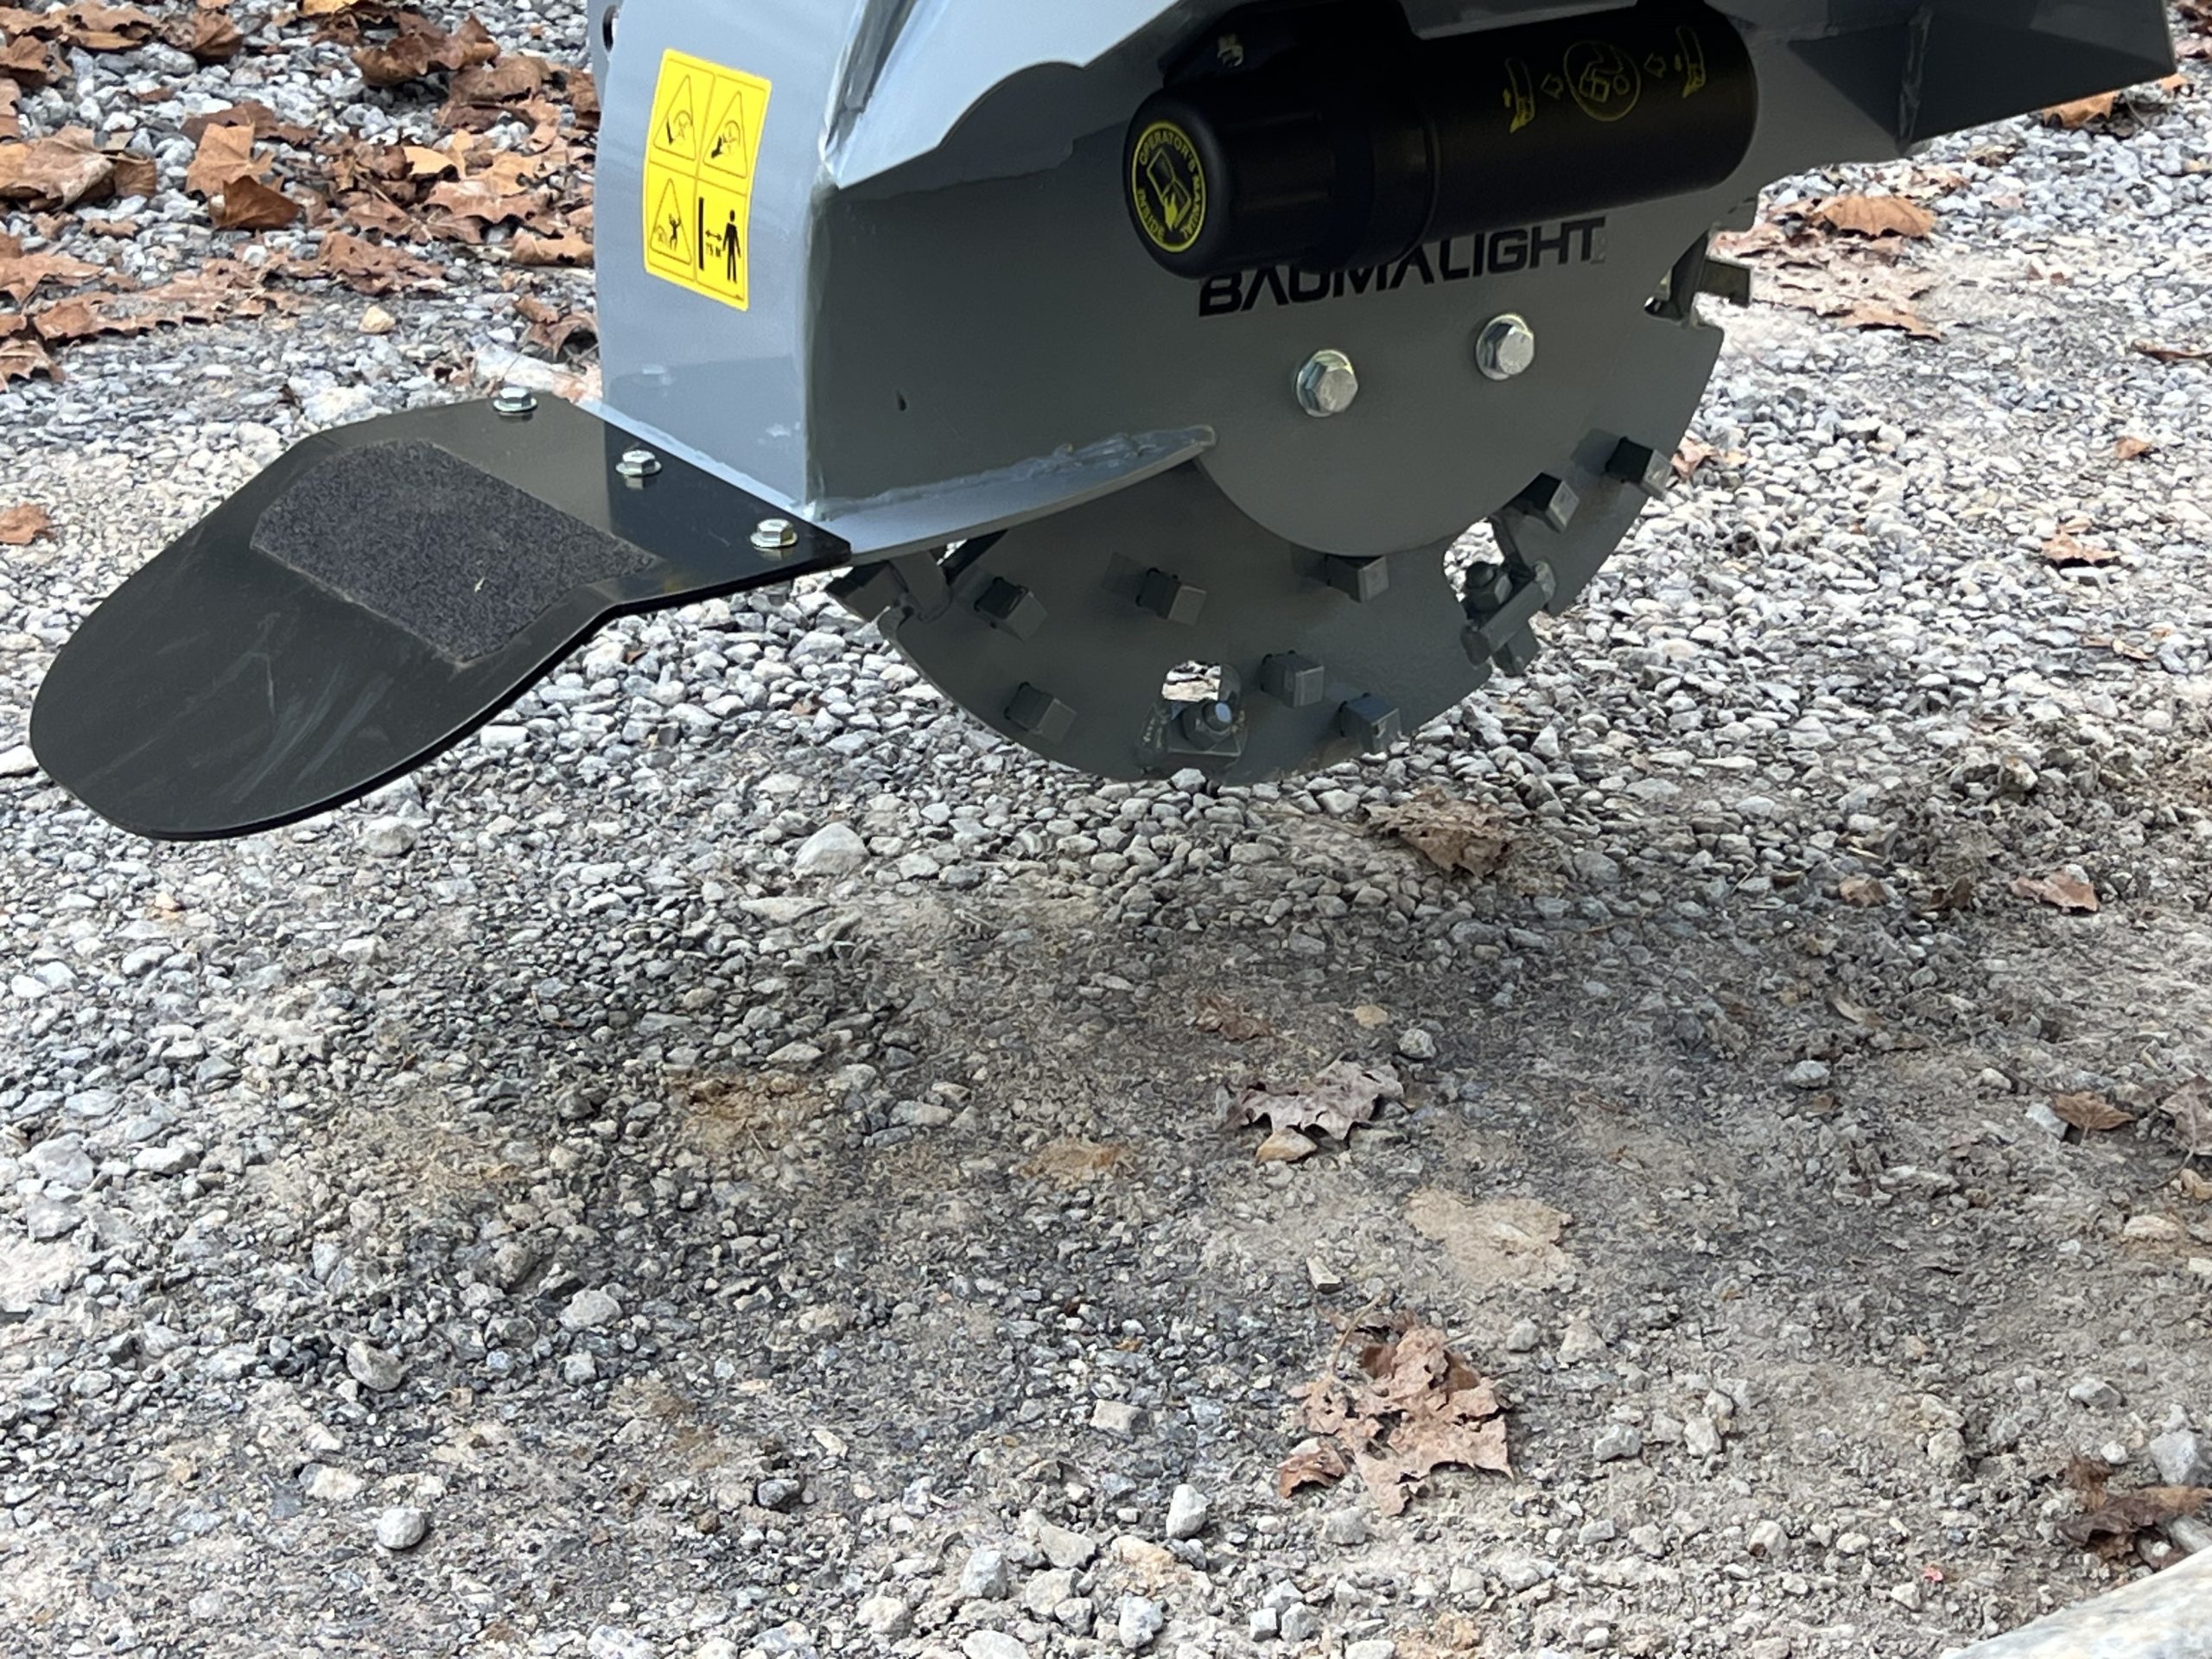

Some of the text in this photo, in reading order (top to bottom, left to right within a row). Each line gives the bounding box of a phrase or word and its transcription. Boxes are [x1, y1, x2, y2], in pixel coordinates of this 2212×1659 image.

[1136, 130, 1202, 243] OPERATOR'S MANUAL INSIDE
